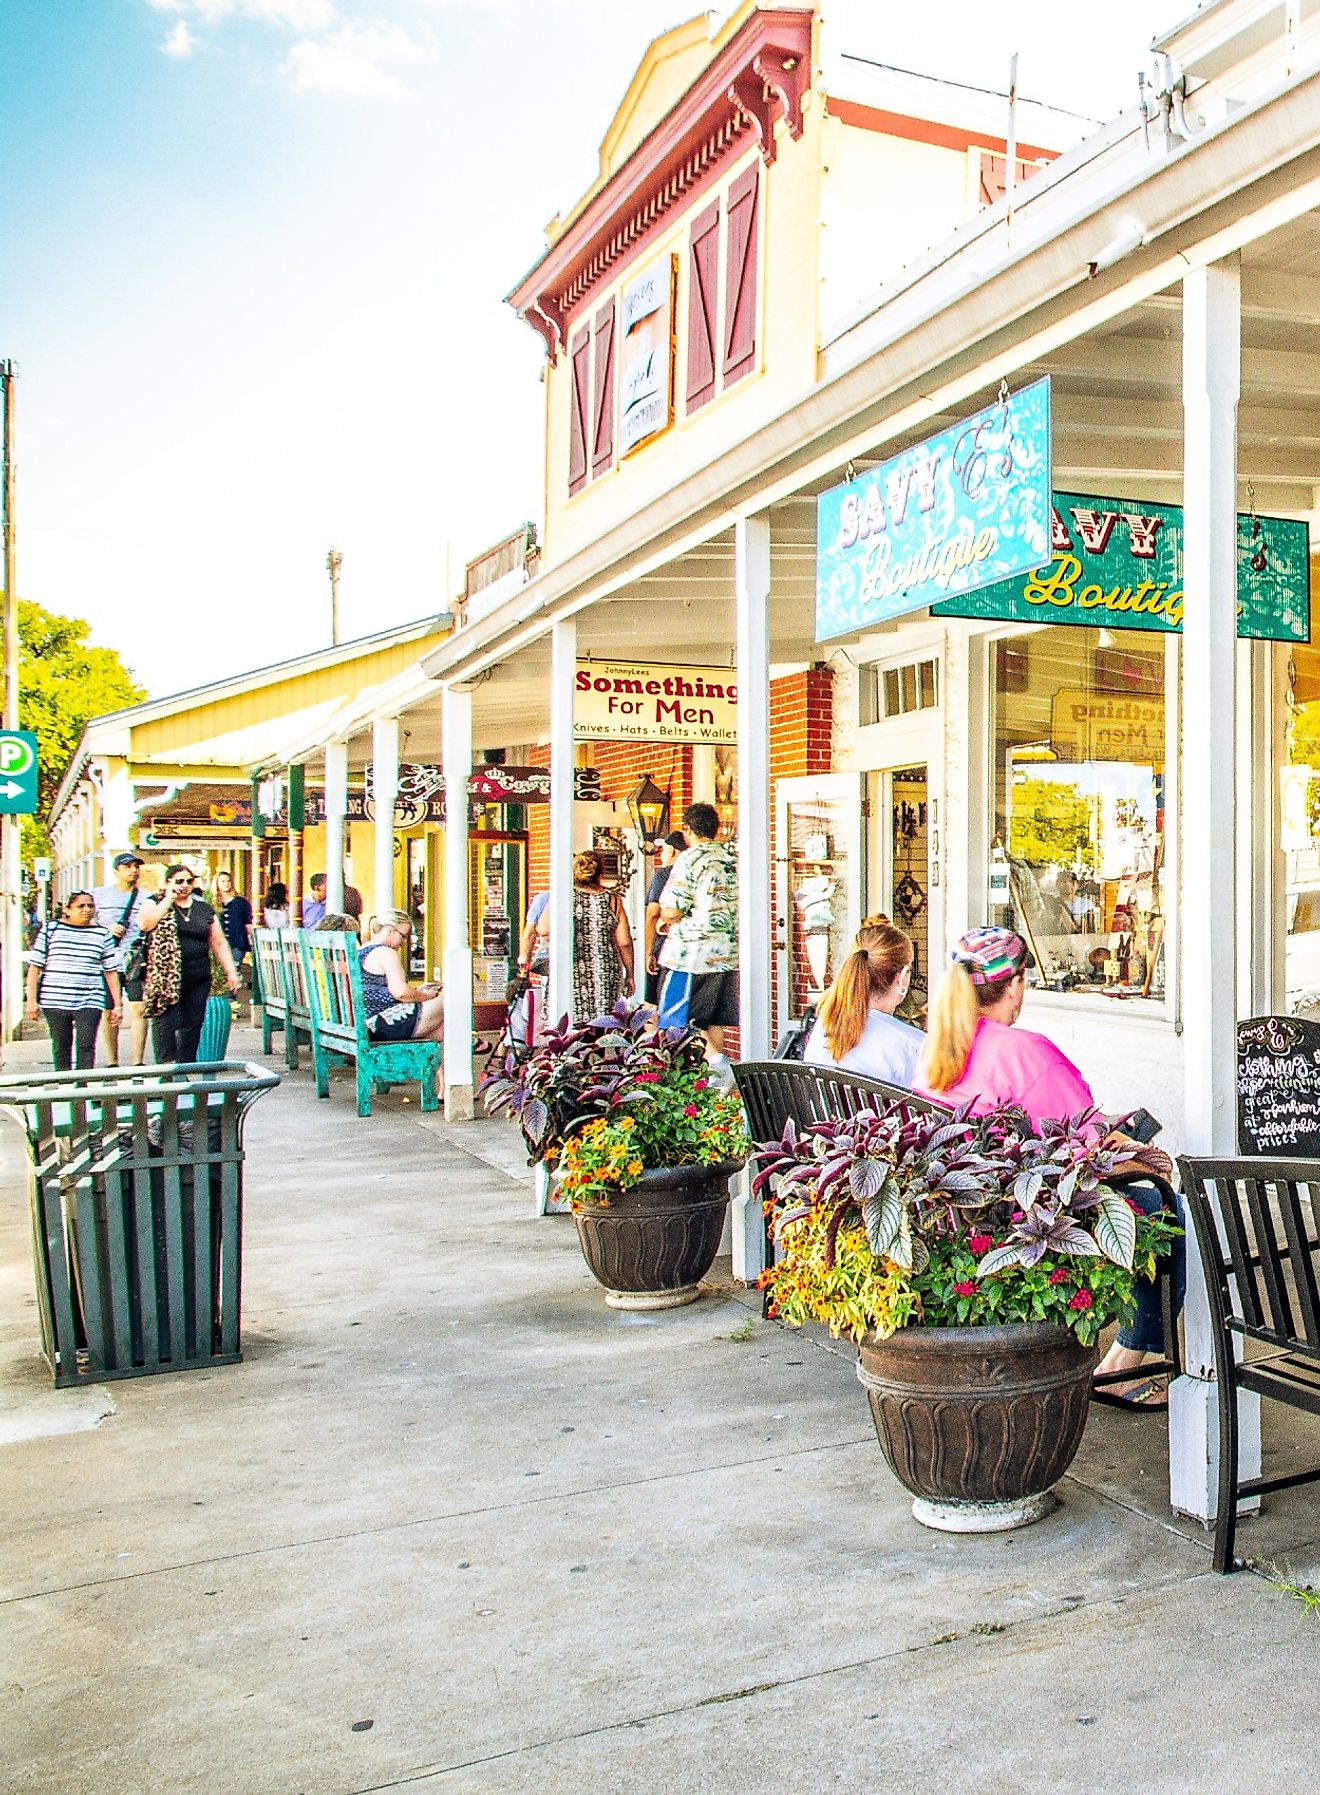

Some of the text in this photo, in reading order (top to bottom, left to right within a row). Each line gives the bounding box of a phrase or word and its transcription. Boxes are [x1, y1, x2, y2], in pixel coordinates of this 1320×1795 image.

[840, 454, 941, 549] SAVY
[860, 528, 996, 604] Boutique
[1024, 553, 1184, 627] Boutiq
[576, 671, 738, 705] Something
[608, 696, 715, 725] For Men
[620, 724, 648, 735] Hats
[659, 726, 689, 737] Belts
[1244, 1090, 1278, 1114] great
[1243, 1114, 1260, 1128] at
[1256, 1133, 1298, 1152] prices
